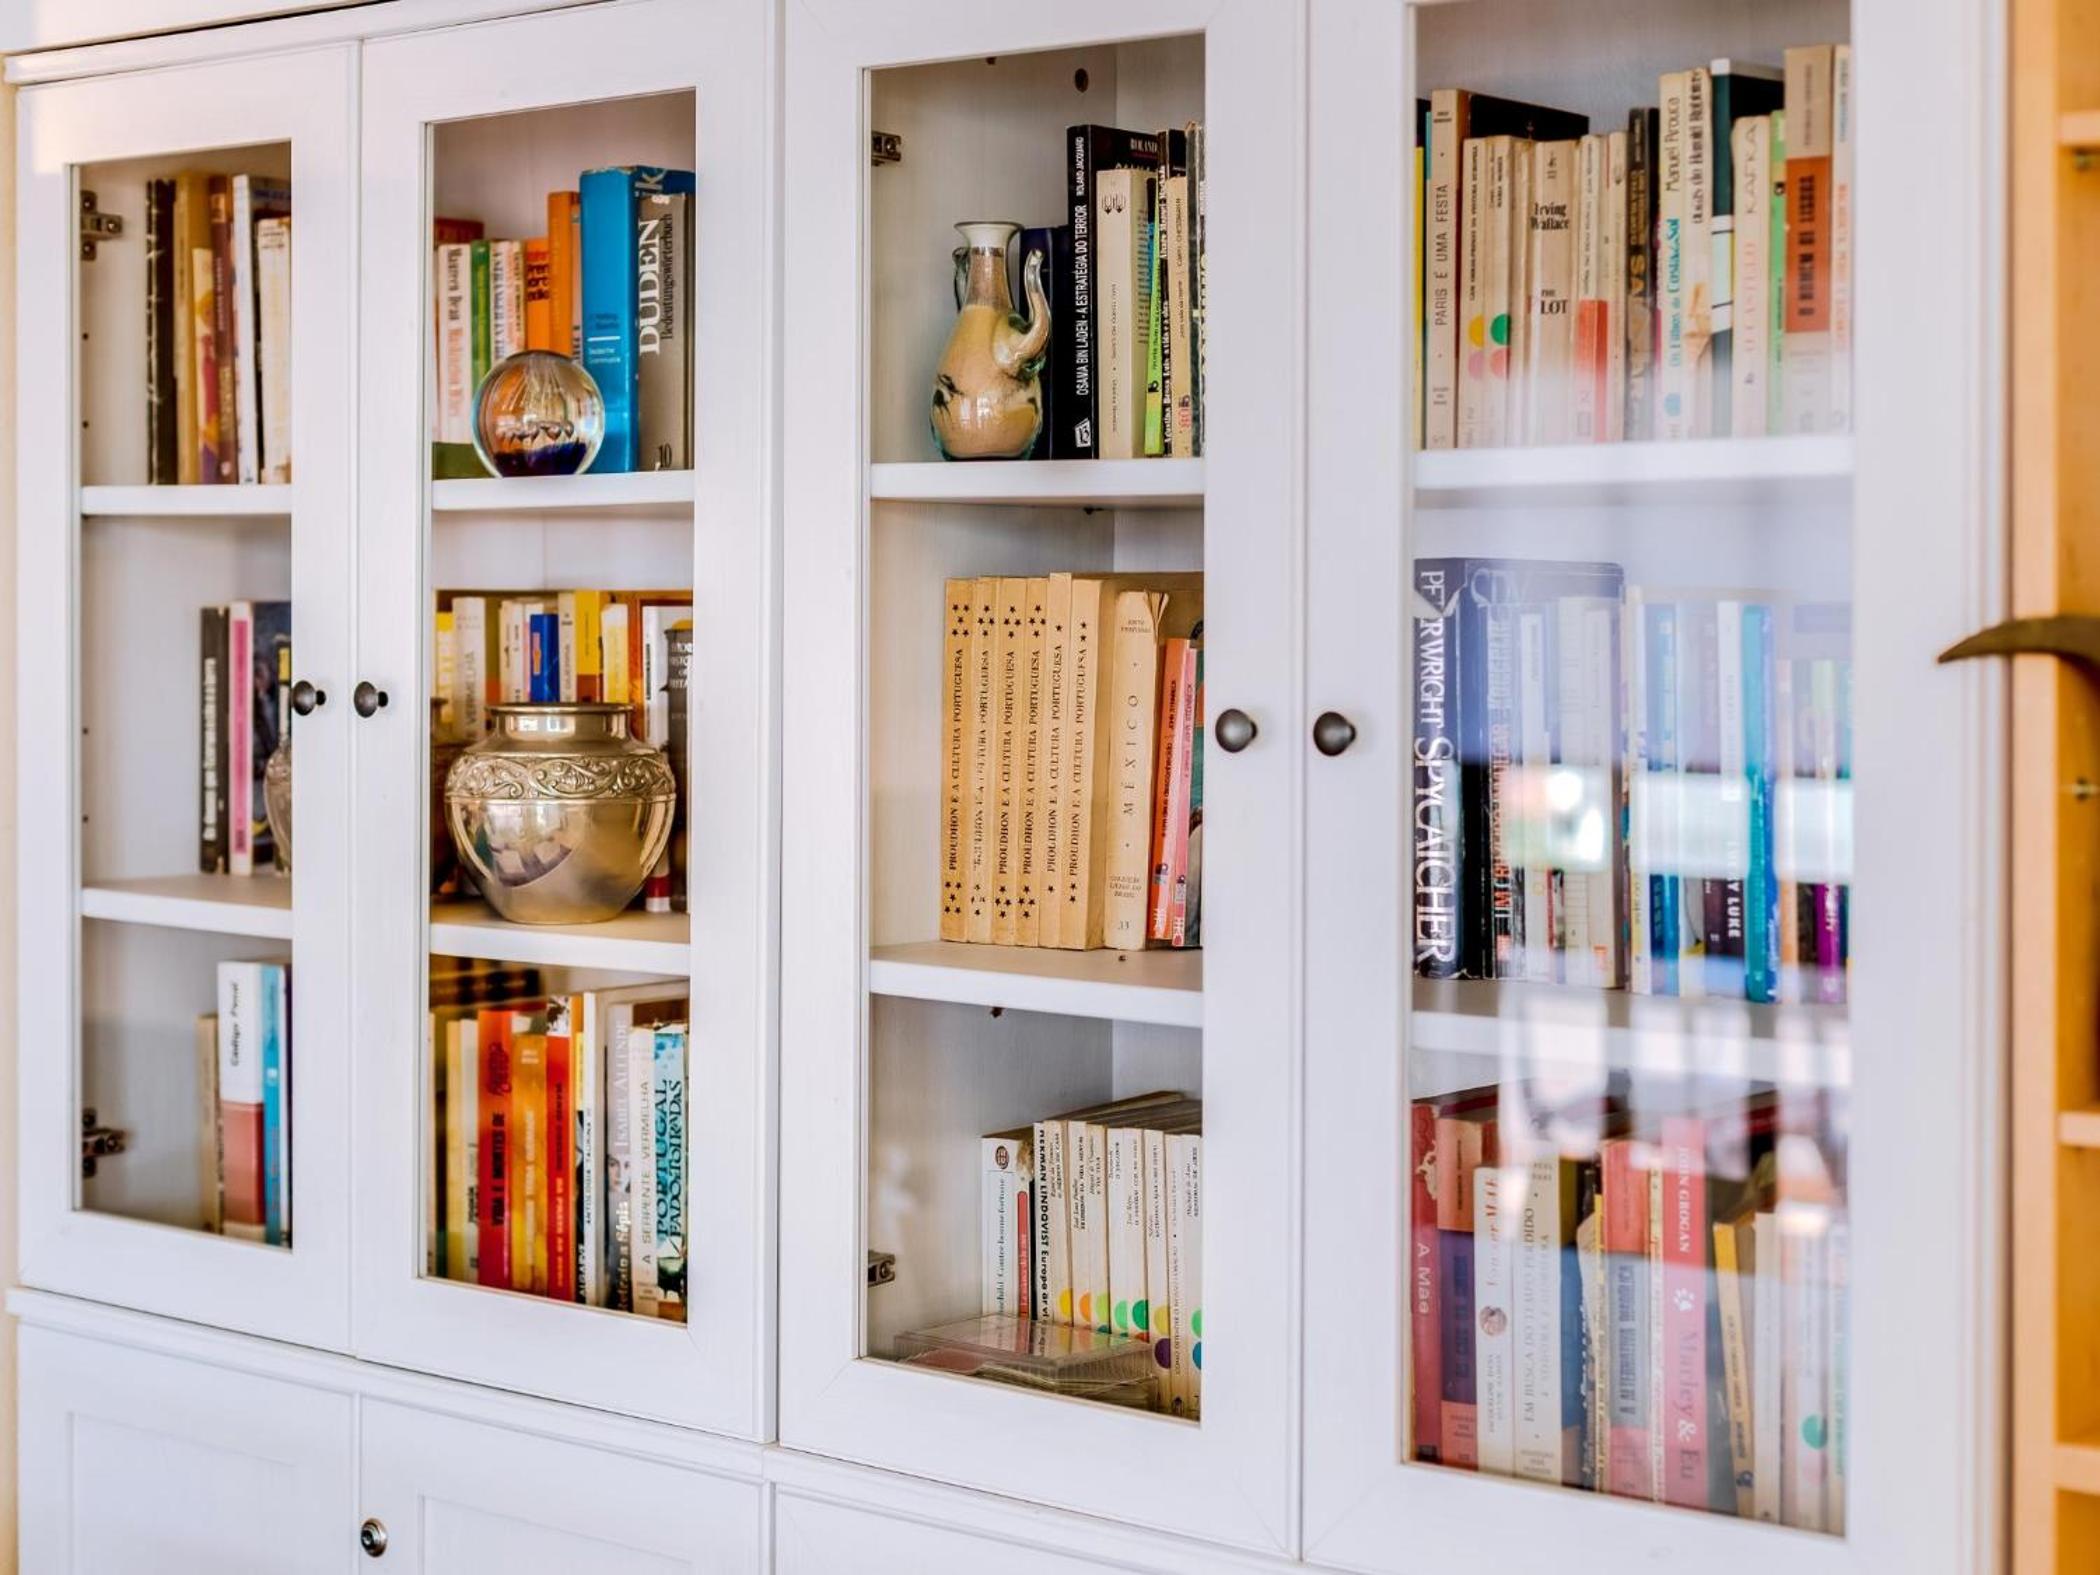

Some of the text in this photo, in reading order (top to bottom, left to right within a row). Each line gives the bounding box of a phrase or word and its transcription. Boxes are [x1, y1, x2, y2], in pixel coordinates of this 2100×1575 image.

[1664, 147, 1680, 191] Manuel
[1744, 124, 1757, 214] KAFKA
[1074, 204, 1088, 239] TERROR
[1435, 184, 1448, 223] FESTA
[1530, 215, 1569, 231] Wallace
[1533, 202, 1567, 218] Irving
[1075, 241, 1088, 255] DO
[1435, 231, 1448, 262] UMA
[637, 218, 660, 356] DUDEN
[660, 212, 675, 341] Bedeutungswörterbuch
[1072, 255, 1088, 307] ESTRATÉGIA
[1075, 307, 1088, 315] A
[1435, 288, 1448, 326] PARIS
[1075, 320, 1088, 349] LADEN
[1075, 350, 1088, 363] BIN
[1075, 365, 1089, 396] OSAMA
[1418, 569, 1446, 729] PER WRIGHT
[954, 648, 964, 722] PORTUGUESA
[1004, 651, 1016, 725] PORTUGUESA
[1052, 644, 1063, 721] PORTUGUESA
[953, 727, 962, 780] CULTURA
[1002, 730, 1013, 783] CULTURA
[1022, 650, 1040, 875] PROUDHON E A CULTURA PORTUGUESA
[1050, 726, 1060, 780] CULTURA
[1069, 648, 1087, 876] PROUDHON E A CULTURA PORTUGUESA
[1120, 694, 1139, 815] MÉXICO
[952, 783, 961, 791] A
[1002, 787, 1011, 795] A
[948, 808, 959, 871] PROUDHON
[998, 811, 1010, 875] PROUDHON
[1047, 809, 1058, 872] PROUDHON
[1414, 736, 1457, 964] SPYCATCHER
[1727, 897, 1741, 937] LUKE
[639, 1081, 652, 1264] A SERPENTE VERMELHA
[1040, 1184, 1050, 1247] LINDQVIST
[1523, 1207, 1535, 1269] PERDIDO
[1679, 1189, 1691, 1253] GROGAN
[1039, 1250, 1049, 1290] Europa
[1417, 1242, 1432, 1258] A
[1679, 1449, 1699, 1481] Eu
